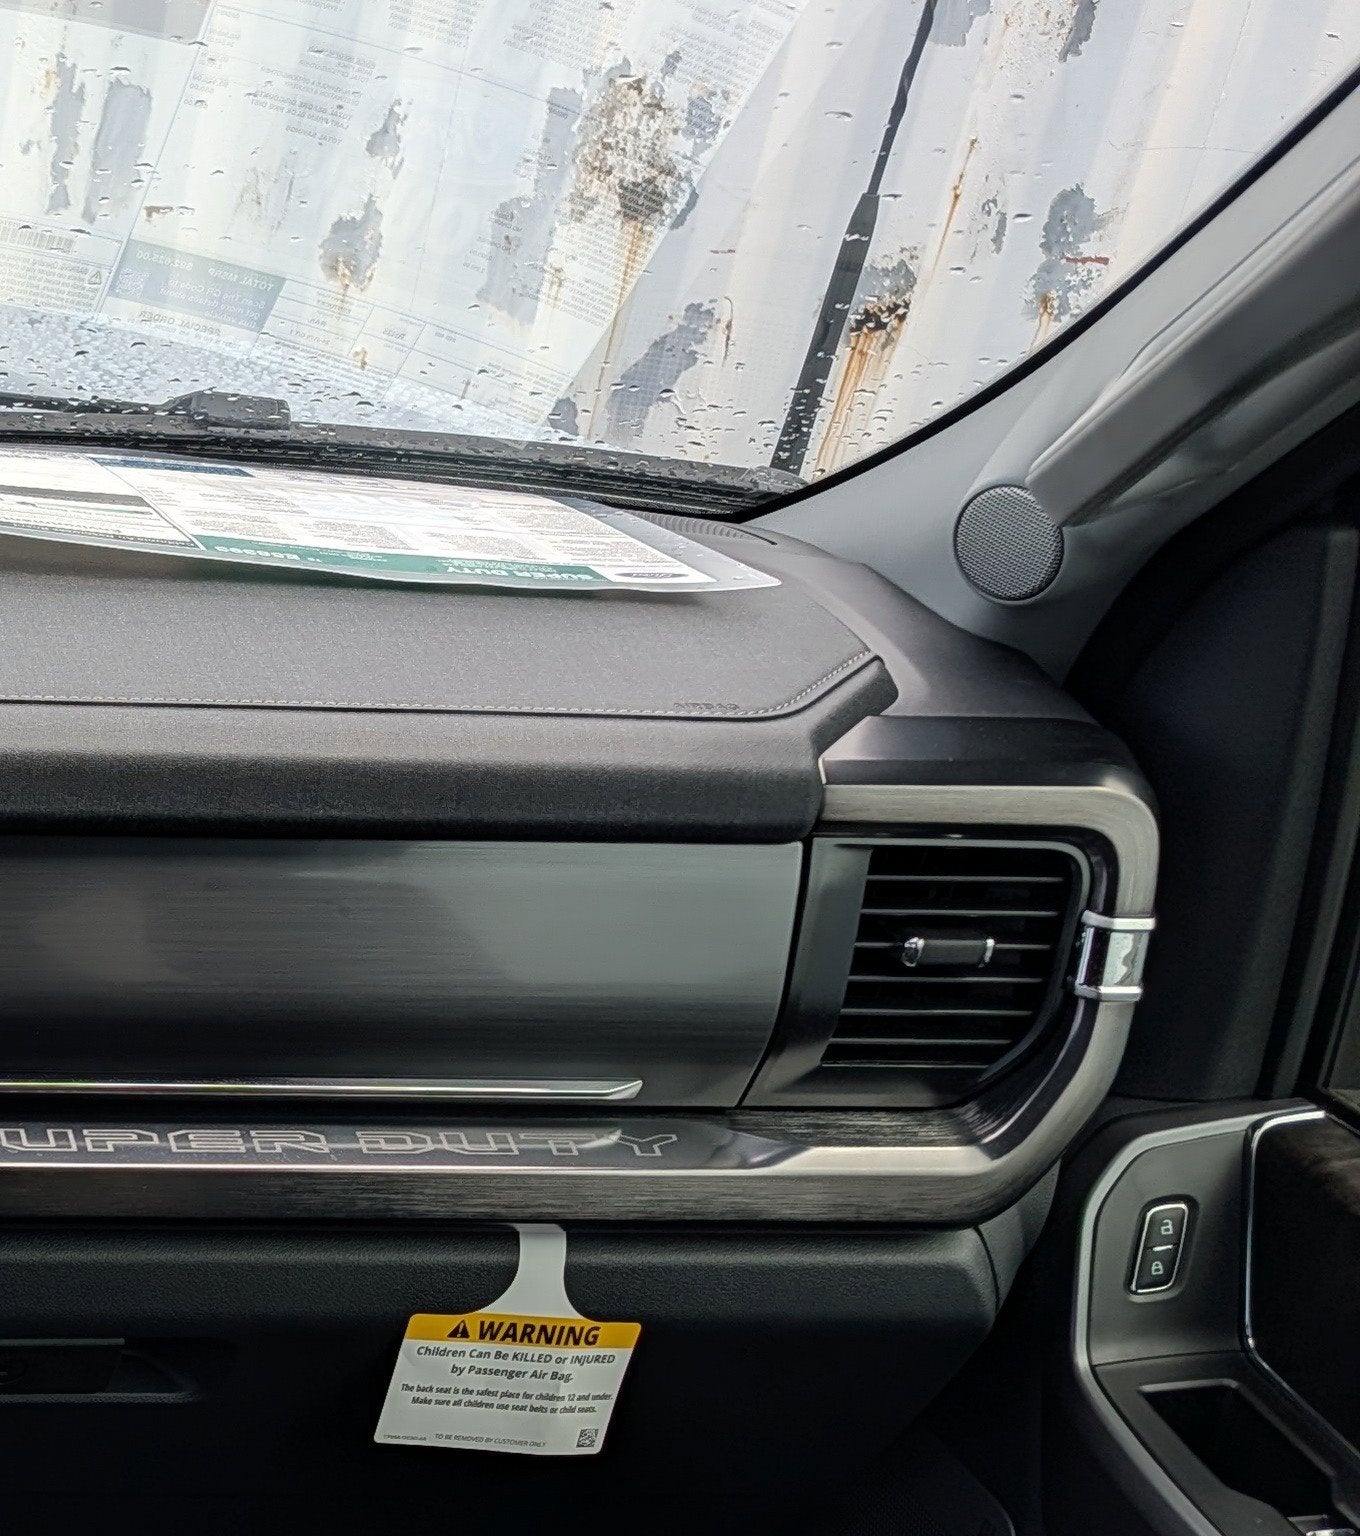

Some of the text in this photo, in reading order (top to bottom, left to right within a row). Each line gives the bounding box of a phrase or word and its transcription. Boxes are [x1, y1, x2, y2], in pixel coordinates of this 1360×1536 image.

[355, 1128, 678, 1158] DUTY
[479, 1320, 601, 1346] WARNING
[416, 1346, 616, 1366] Children Can Be KILLED or INJURED
[451, 1364, 465, 1376] by
[468, 1365, 527, 1380] Passenger
[529, 1370, 548, 1379] Air
[401, 1384, 414, 1392] The
[416, 1385, 434, 1393] back
[453, 1387, 460, 1395] is
[462, 1388, 475, 1396] the
[476, 1388, 499, 1397] safest
[500, 1391, 521, 1400] place
[522, 1391, 535, 1400] for
[535, 1393, 565, 1402] children
[567, 1394, 576, 1402] 12
[577, 1393, 590, 1401] and
[411, 1397, 432, 1405] Make
[434, 1398, 450, 1406] sure
[464, 1400, 494, 1409] children
[496, 1402, 510, 1410] use
[511, 1403, 528, 1411] seat
[529, 1404, 548, 1413] belts
[560, 1405, 576, 1414] child
